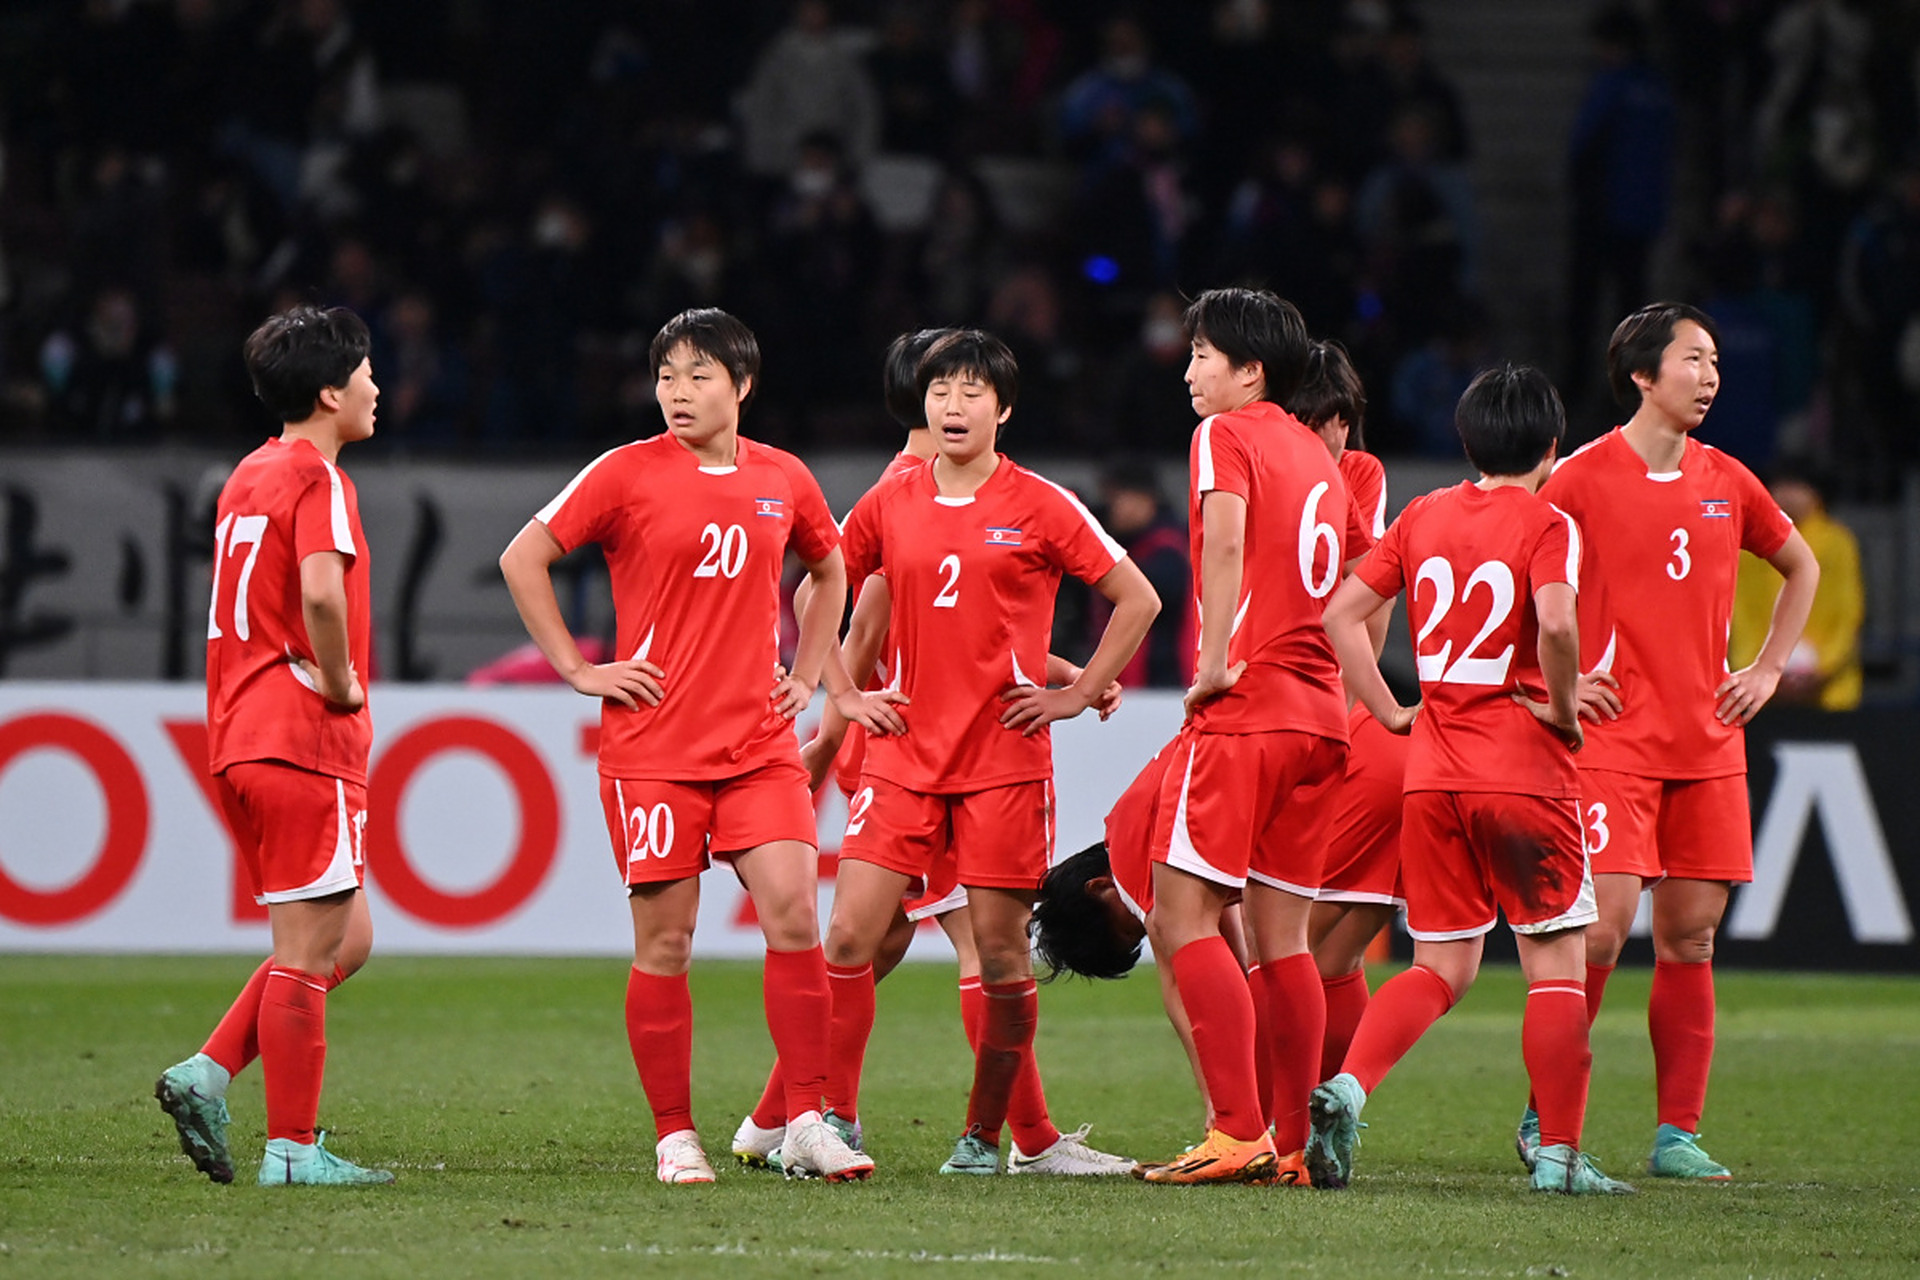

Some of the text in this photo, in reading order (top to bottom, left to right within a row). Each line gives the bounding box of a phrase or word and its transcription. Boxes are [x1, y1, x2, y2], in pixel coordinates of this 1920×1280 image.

[693, 522, 748, 579] 20
[1298, 480, 1340, 599] 6
[1666, 527, 1691, 581] 3
[207, 511, 269, 642] 17
[933, 554, 961, 608] 2
[1414, 556, 1515, 686] 22
[352, 809, 368, 866] 1
[629, 802, 675, 863] 20
[844, 786, 875, 836] 2
[1587, 802, 1610, 854] 3
